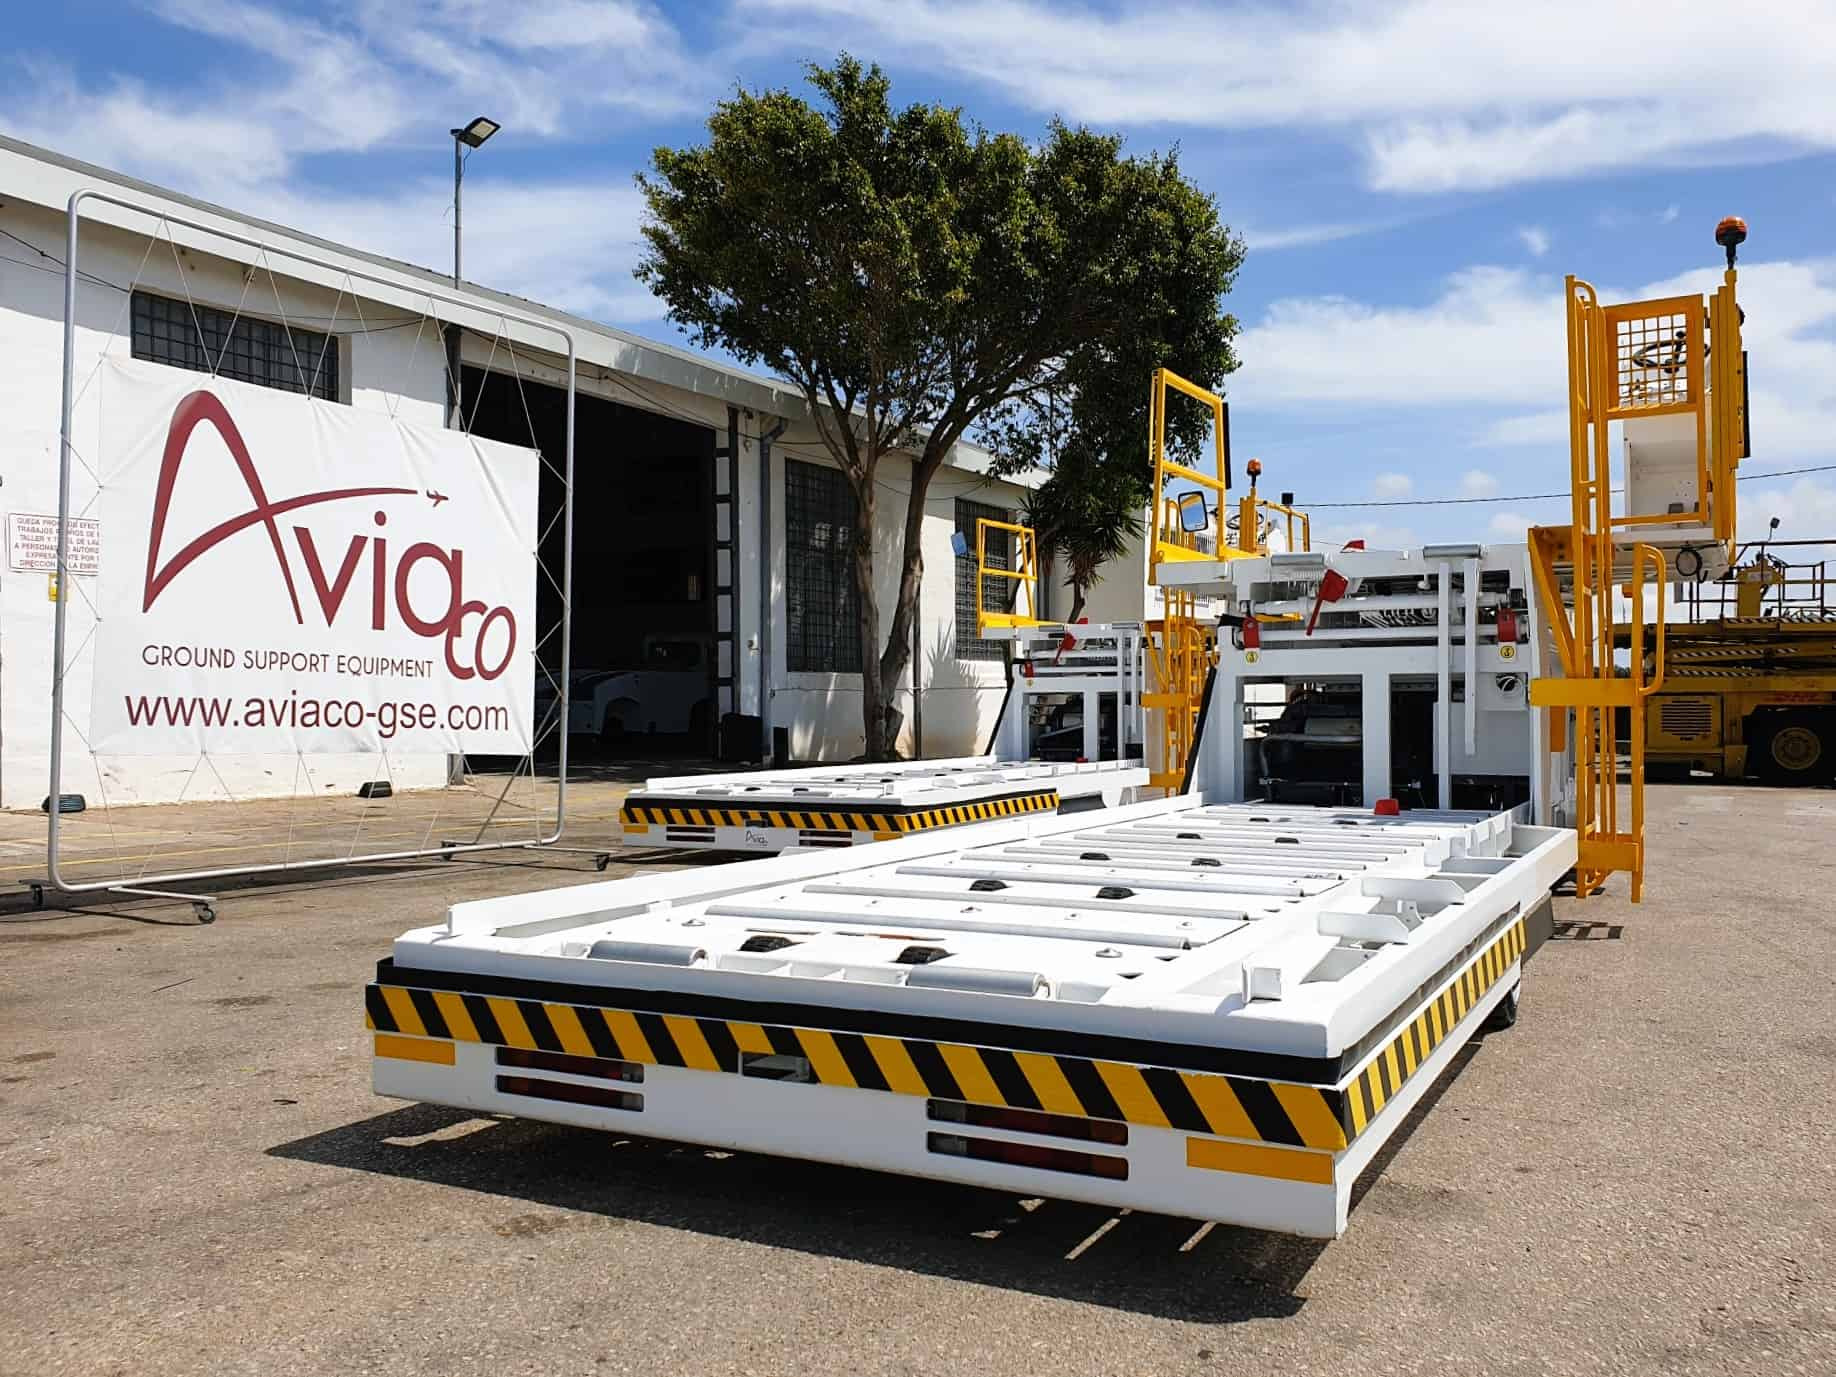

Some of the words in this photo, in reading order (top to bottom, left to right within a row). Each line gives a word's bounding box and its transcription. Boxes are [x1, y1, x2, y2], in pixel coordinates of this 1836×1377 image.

[142, 390, 517, 680] Aviaco
[142, 644, 236, 669] GROUND
[243, 649, 330, 673] SUPPORT
[336, 654, 433, 679] EQUIPMENT
[125, 689, 509, 739] www.aviaco-gse.com
